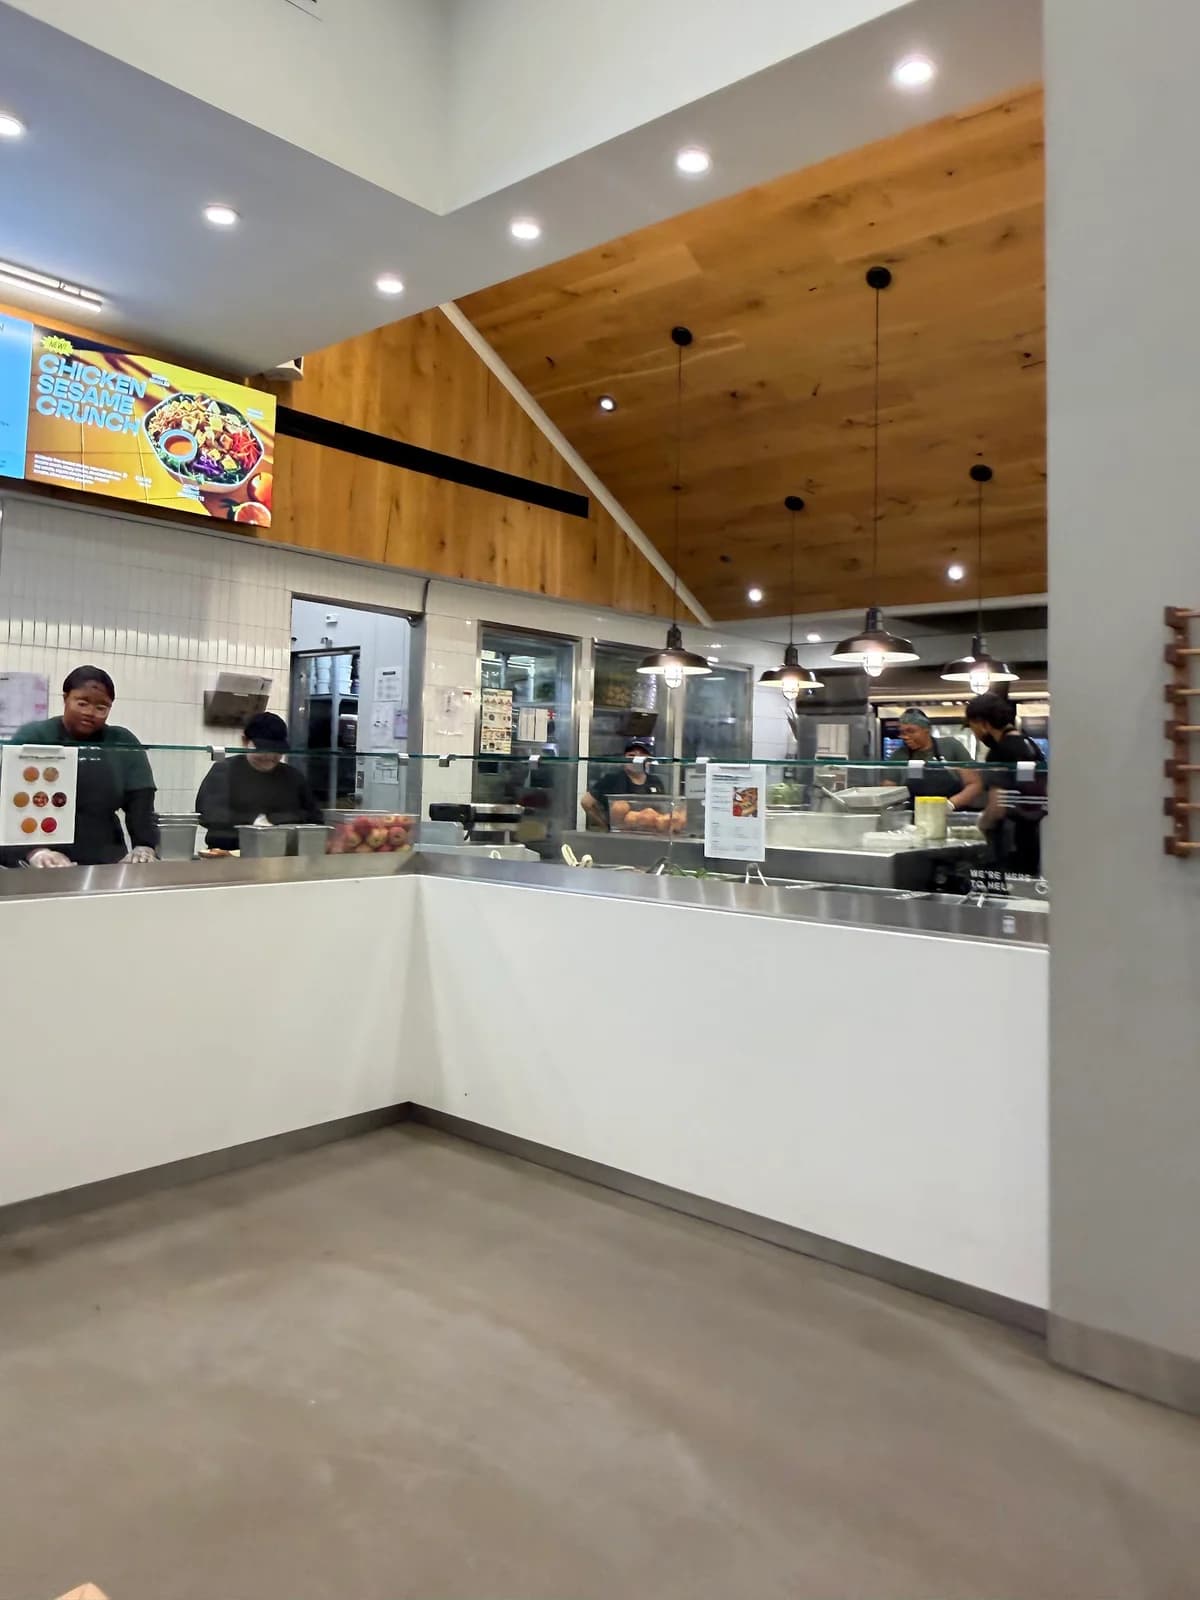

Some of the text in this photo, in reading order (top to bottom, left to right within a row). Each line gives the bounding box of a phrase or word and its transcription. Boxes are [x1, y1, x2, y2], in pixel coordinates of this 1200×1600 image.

[37, 375, 136, 415] SESAME
[39, 354, 147, 398] CHICKEN
[36, 395, 141, 436] CRUNCH
[969, 869, 1002, 880] WE'RE
[970, 879, 986, 890] TO
